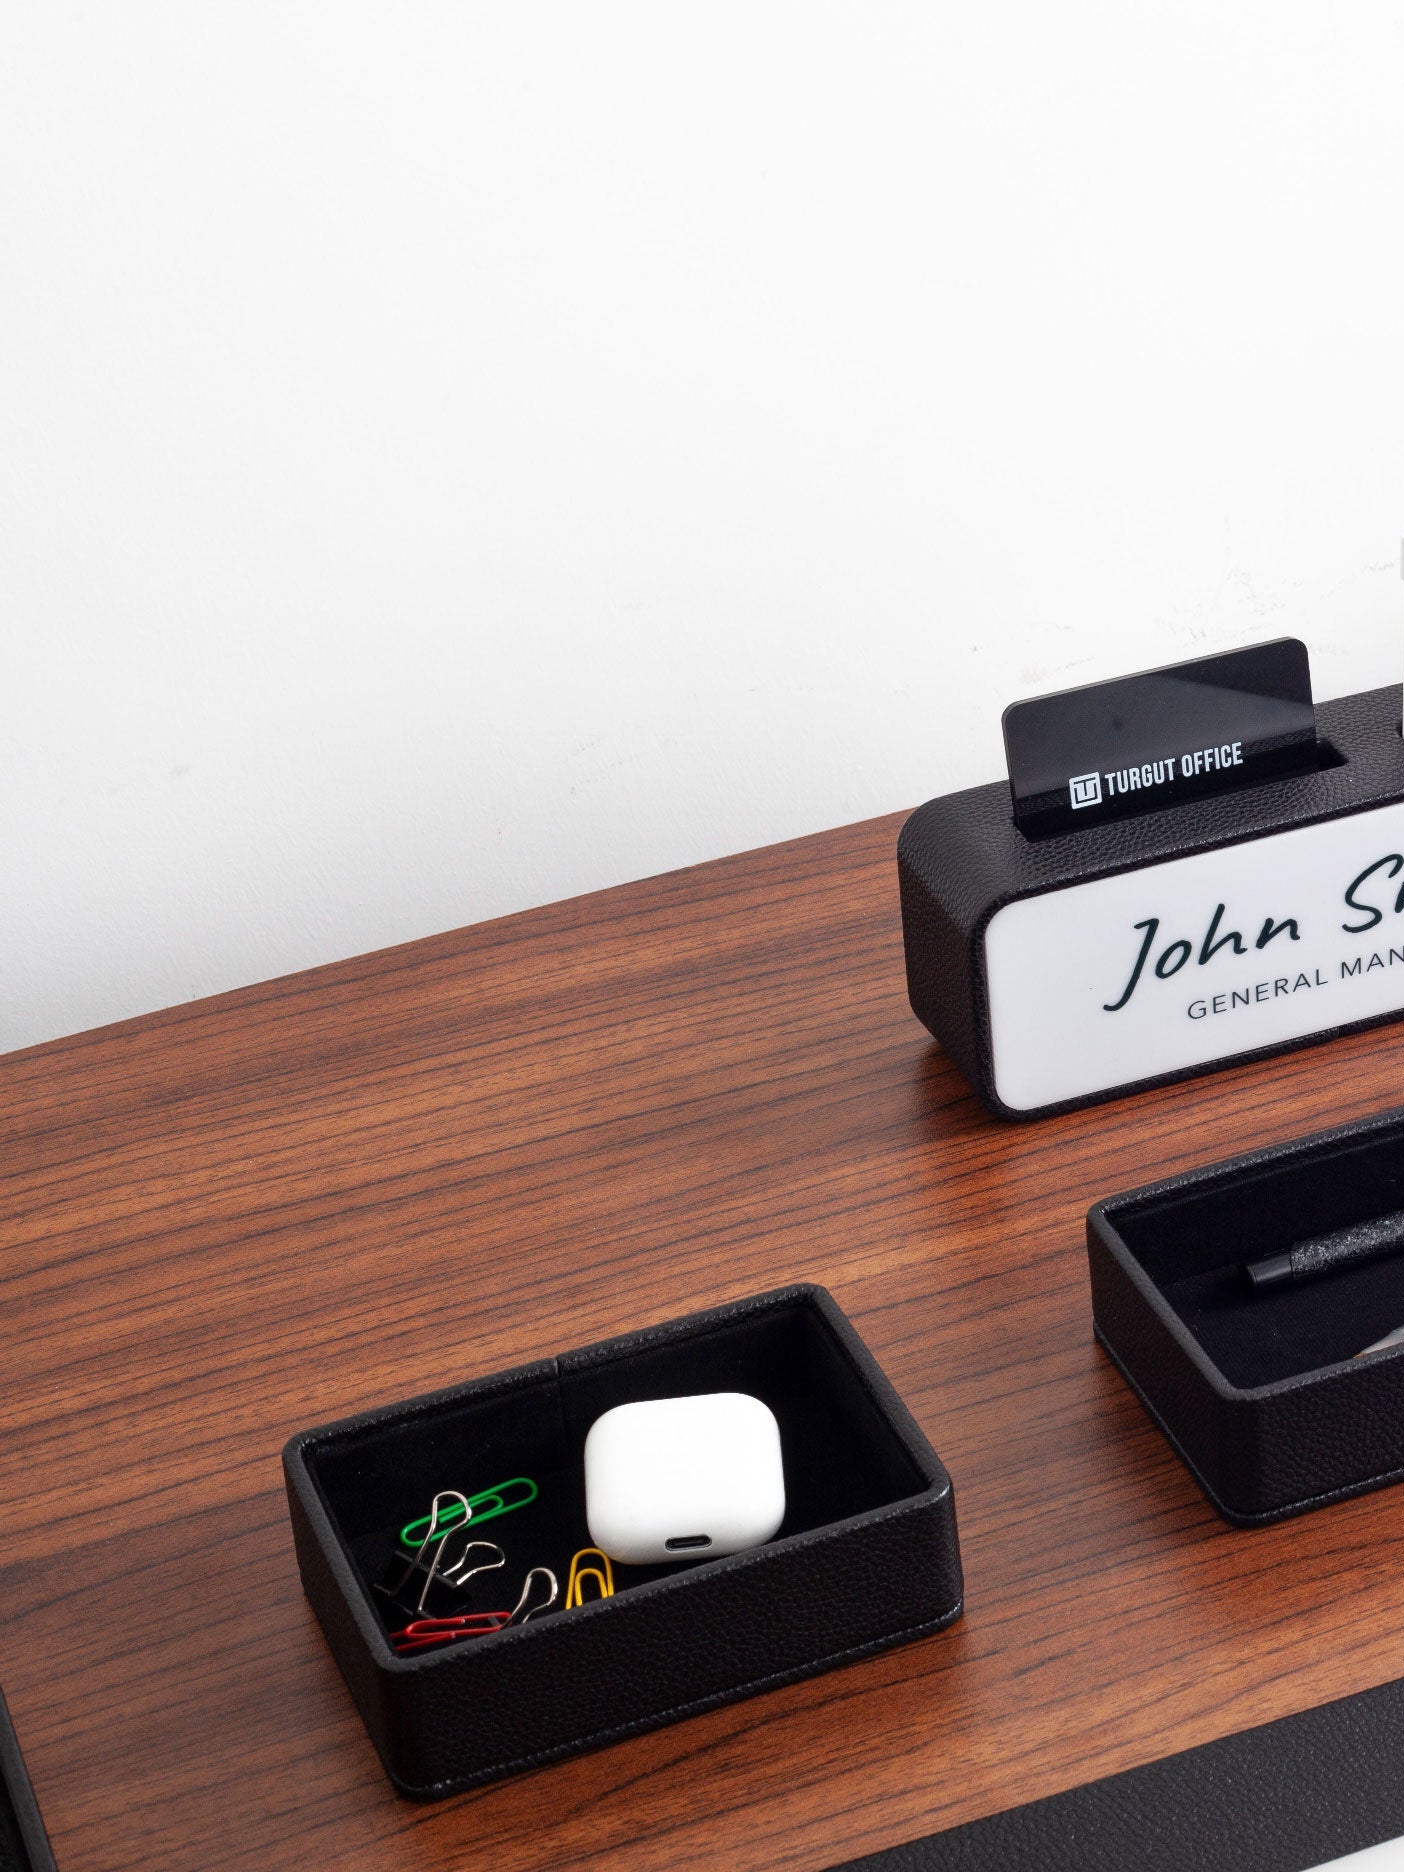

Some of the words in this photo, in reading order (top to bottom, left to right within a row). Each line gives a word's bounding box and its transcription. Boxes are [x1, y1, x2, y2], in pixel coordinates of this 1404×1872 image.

[1105, 758, 1176, 796] TURGUT
[1181, 742, 1243, 778] OFFICE
[1103, 904, 1300, 1012] John
[1187, 969, 1329, 1020] GENERAL
